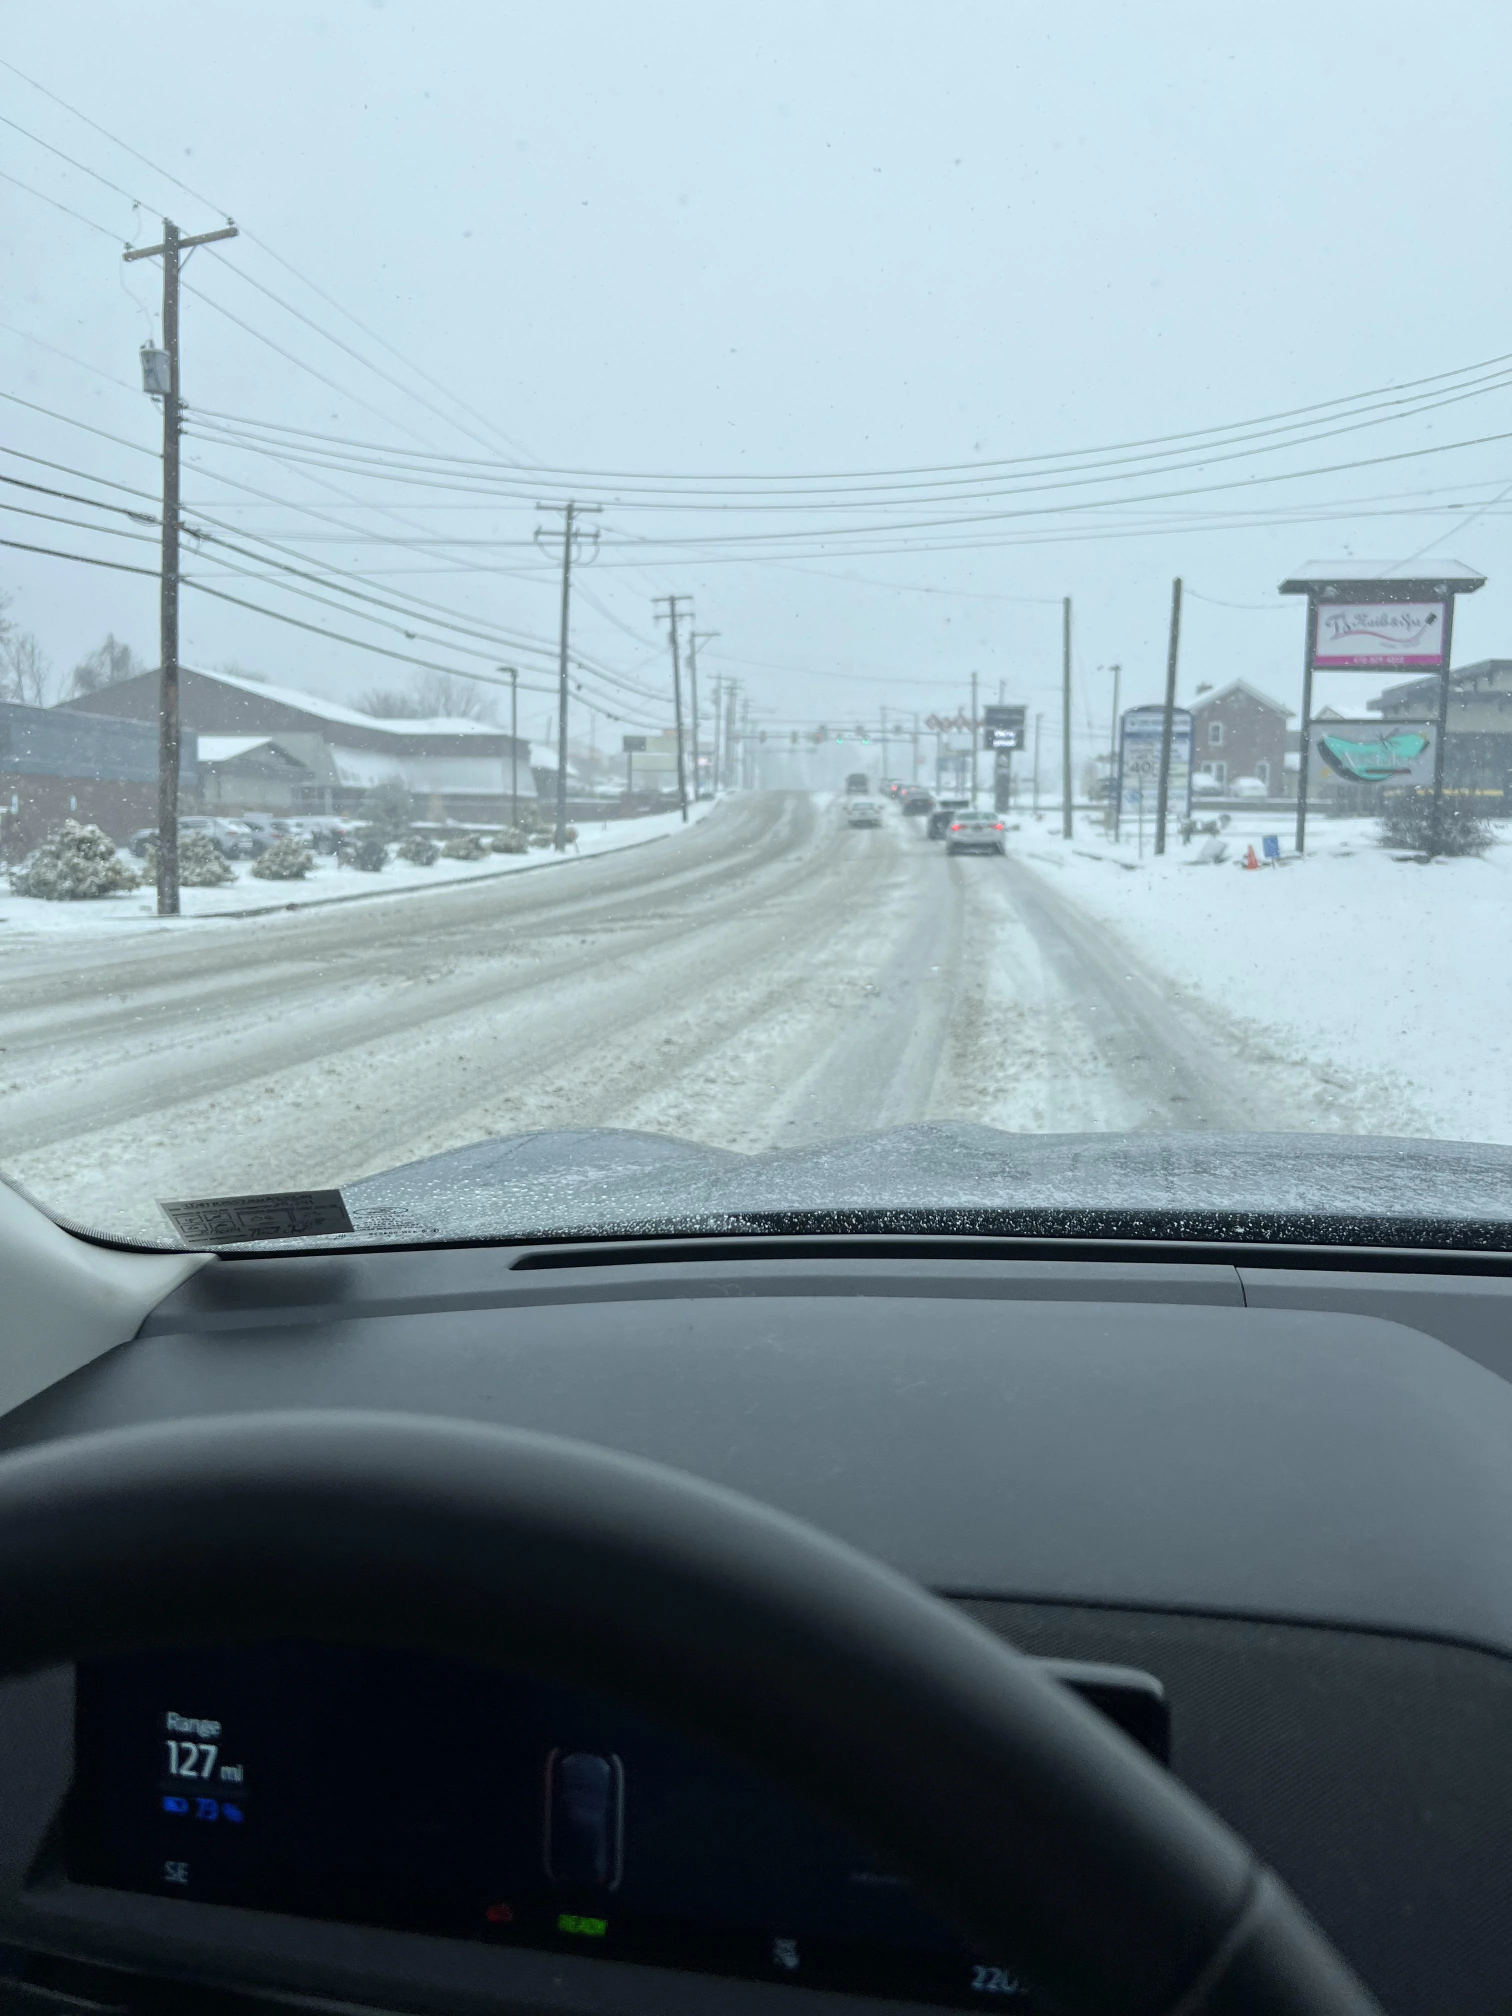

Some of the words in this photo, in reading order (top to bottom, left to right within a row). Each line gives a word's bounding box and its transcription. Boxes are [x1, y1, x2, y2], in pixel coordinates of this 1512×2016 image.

[1130, 761, 1151, 774] 40
[166, 1711, 222, 1738] Range
[166, 1740, 218, 1780] 127
[220, 1764, 244, 1784] mi
[164, 1861, 189, 1884] SE
